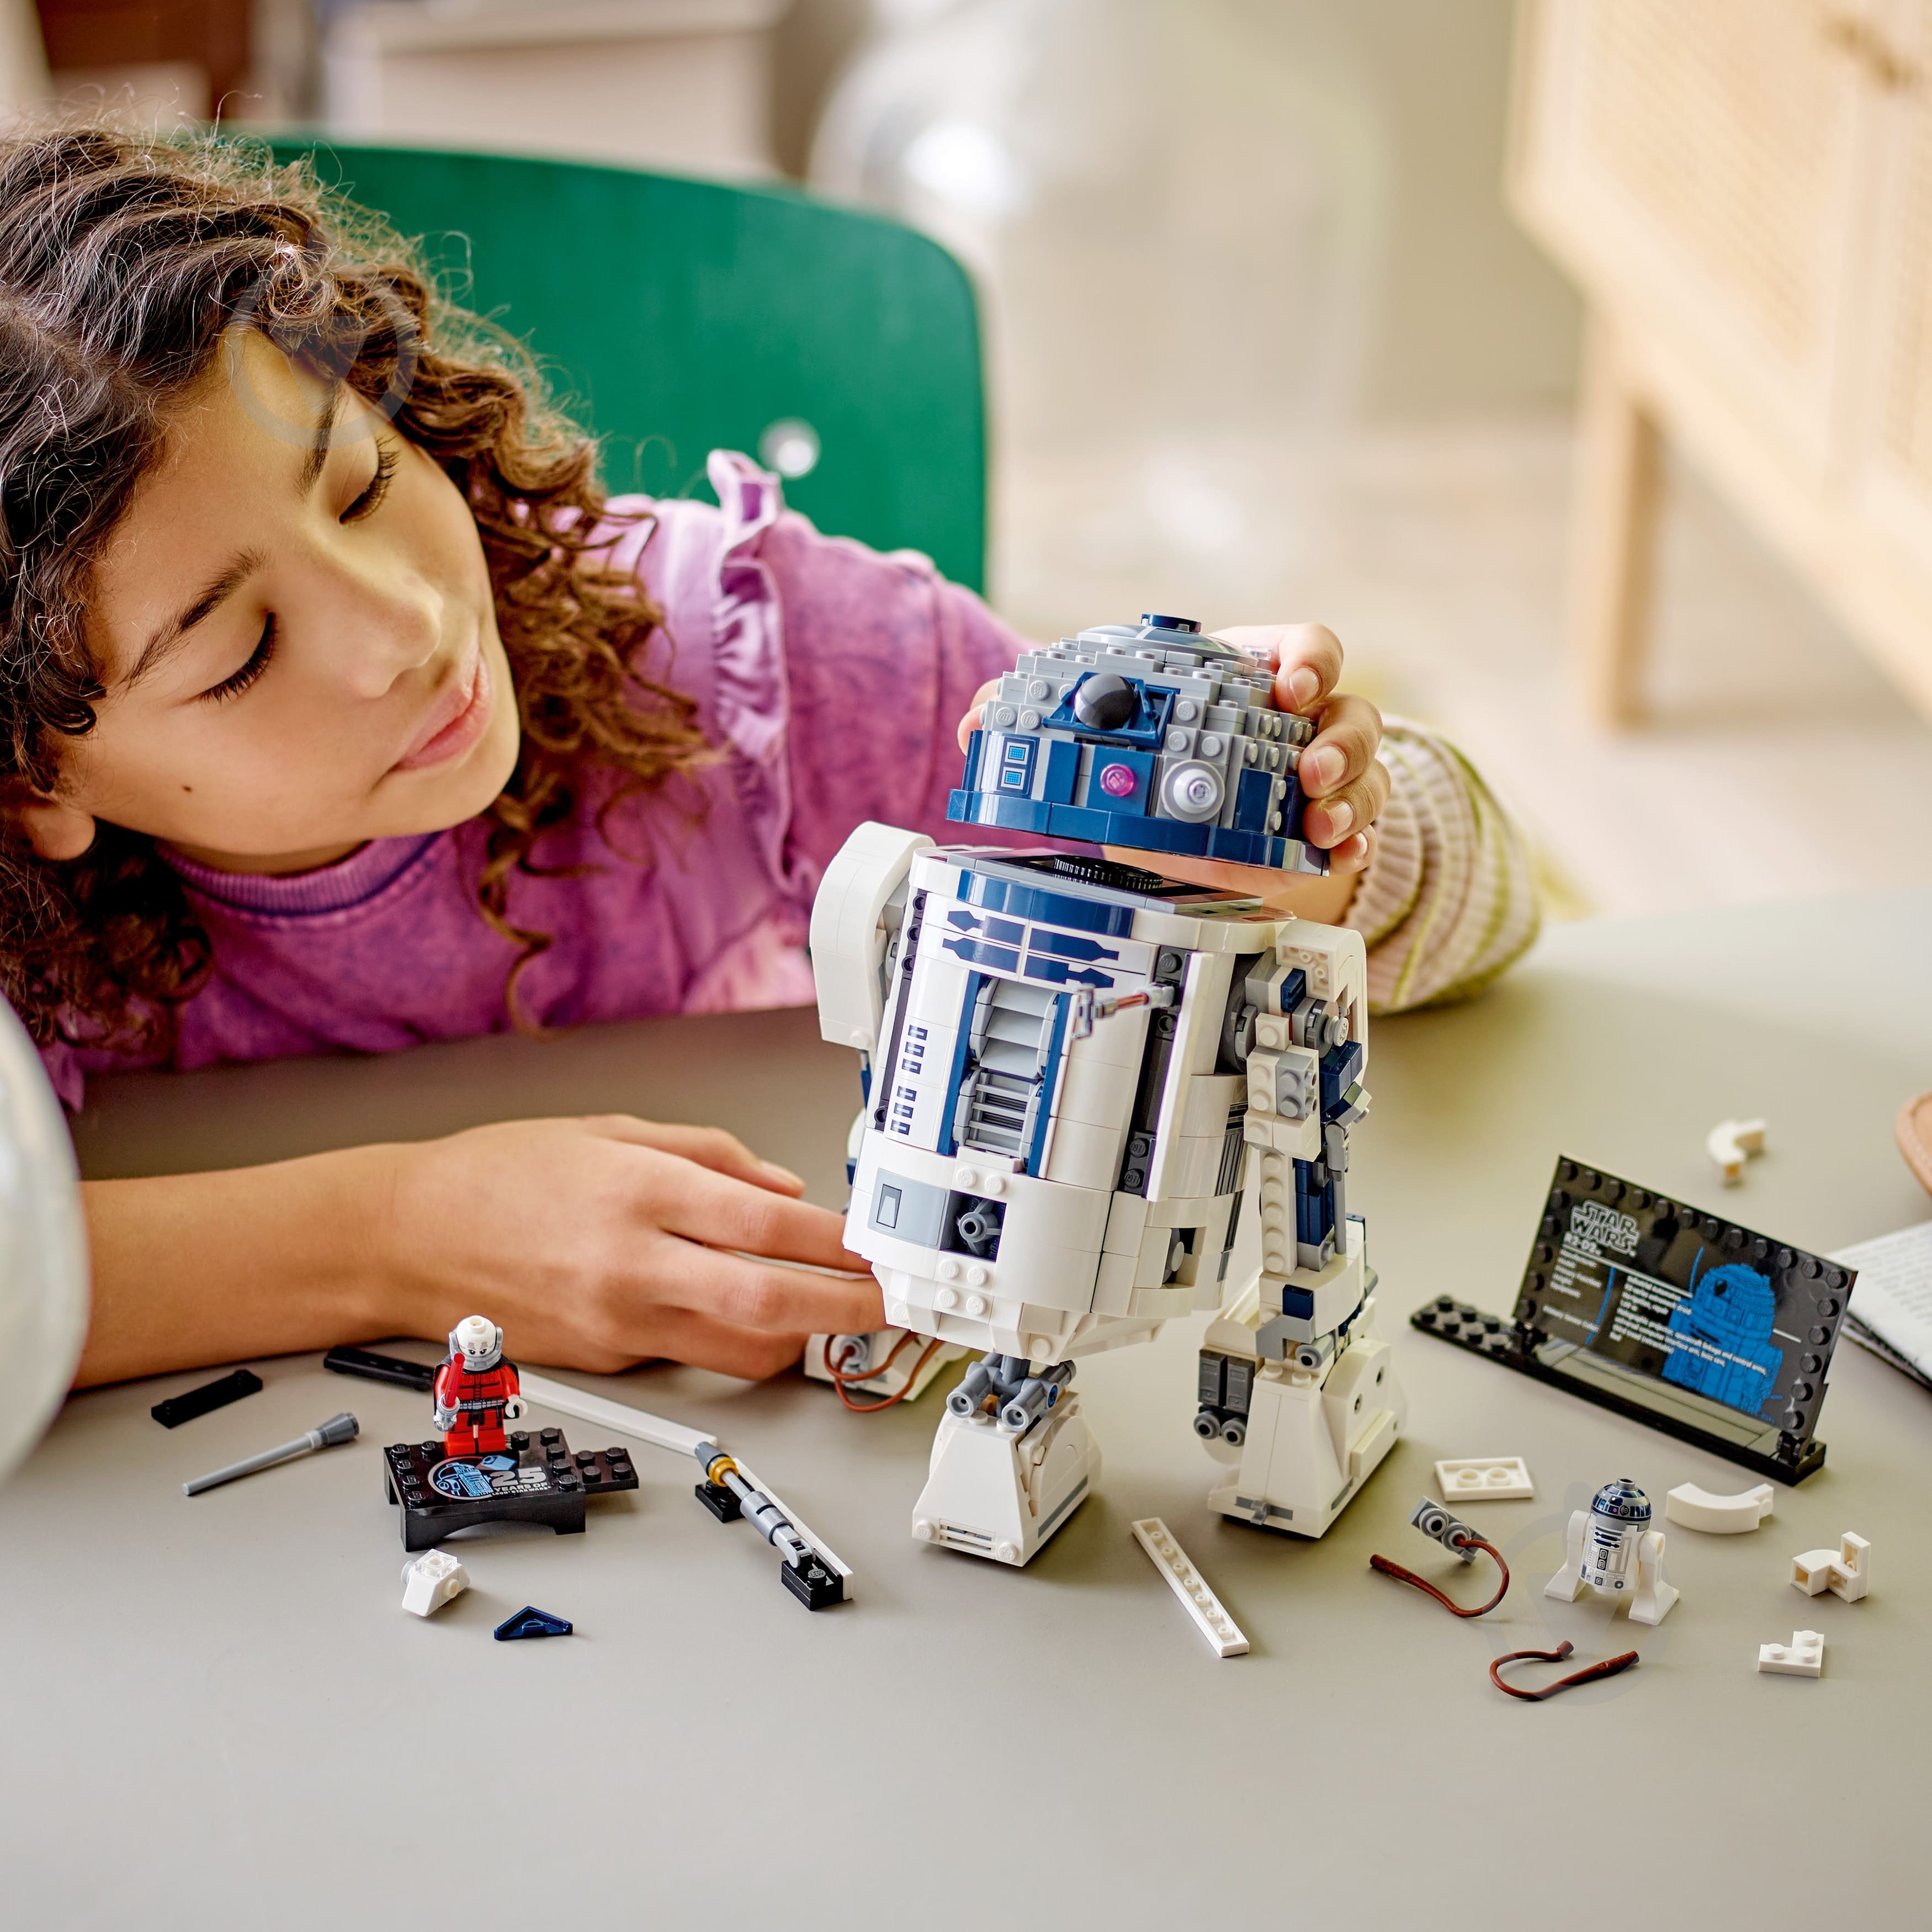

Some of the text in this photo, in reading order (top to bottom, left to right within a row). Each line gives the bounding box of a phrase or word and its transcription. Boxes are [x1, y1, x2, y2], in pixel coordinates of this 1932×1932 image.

[1571, 1199, 1639, 1234] STAR
[1570, 1215, 1639, 1255] WARS
[1676, 1304, 1692, 1315] droid
[1722, 1351, 1733, 1360] and
[1732, 1356, 1752, 1368] control
[490, 1467, 546, 1487] 25
[493, 1483, 532, 1492] YEARS
